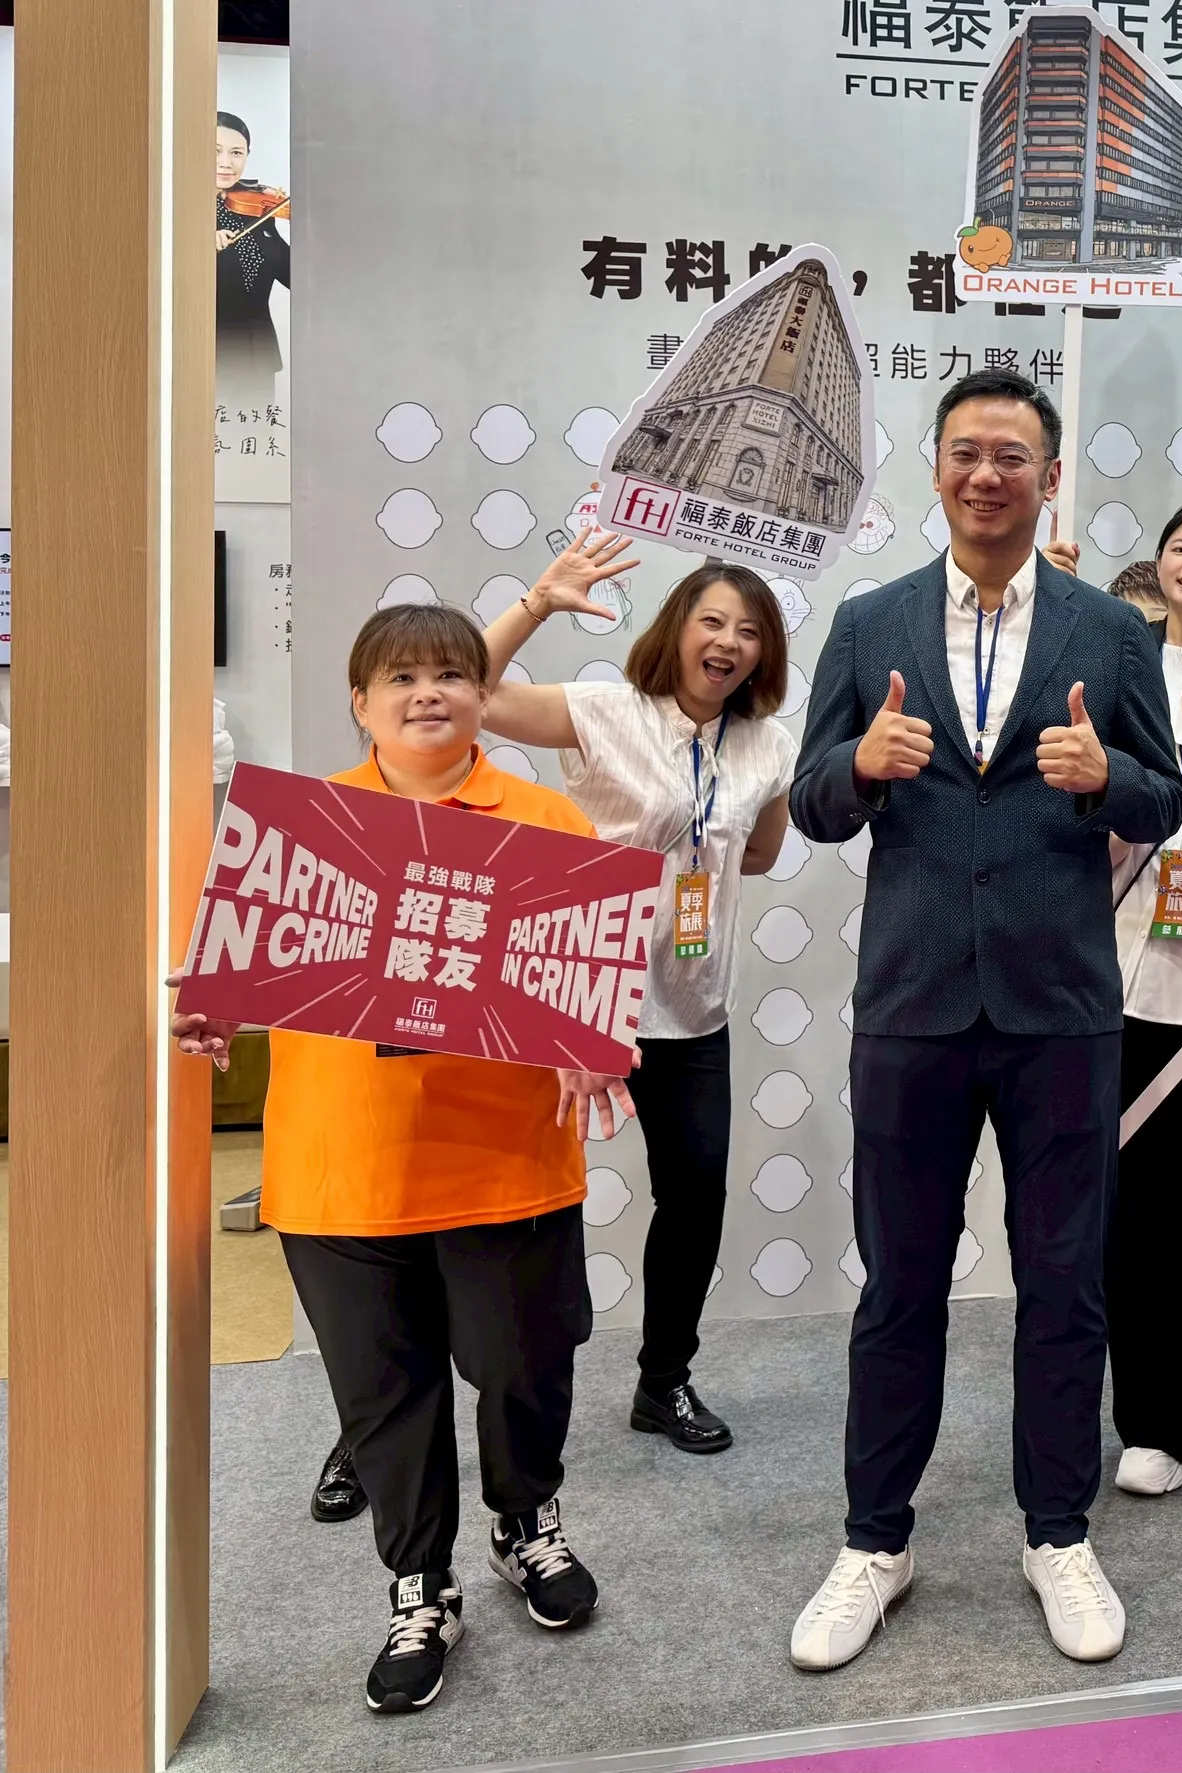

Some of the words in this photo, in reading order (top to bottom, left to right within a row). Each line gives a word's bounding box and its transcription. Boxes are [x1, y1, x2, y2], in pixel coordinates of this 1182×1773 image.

[845, 74, 979, 102] FORTE
[1024, 199, 1074, 207] ORANGE
[963, 274, 1078, 294] ORANGE
[752, 409, 778, 422] HOTEL
[675, 529, 719, 547] FORTE
[724, 541, 767, 559] HOTEL
[771, 553, 816, 571] GROUP
[680, 498, 827, 557] 福泰飯店集團
[206, 801, 379, 928] PARTNER
[403, 861, 496, 896] 最強戰隊
[183, 896, 263, 977] IN
[267, 911, 373, 968] CRIME
[394, 887, 491, 942] 招募
[509, 885, 661, 962] PARTNER
[383, 936, 482, 992] 隊友
[502, 953, 520, 989] IN
[521, 956, 648, 1047] CRIME
